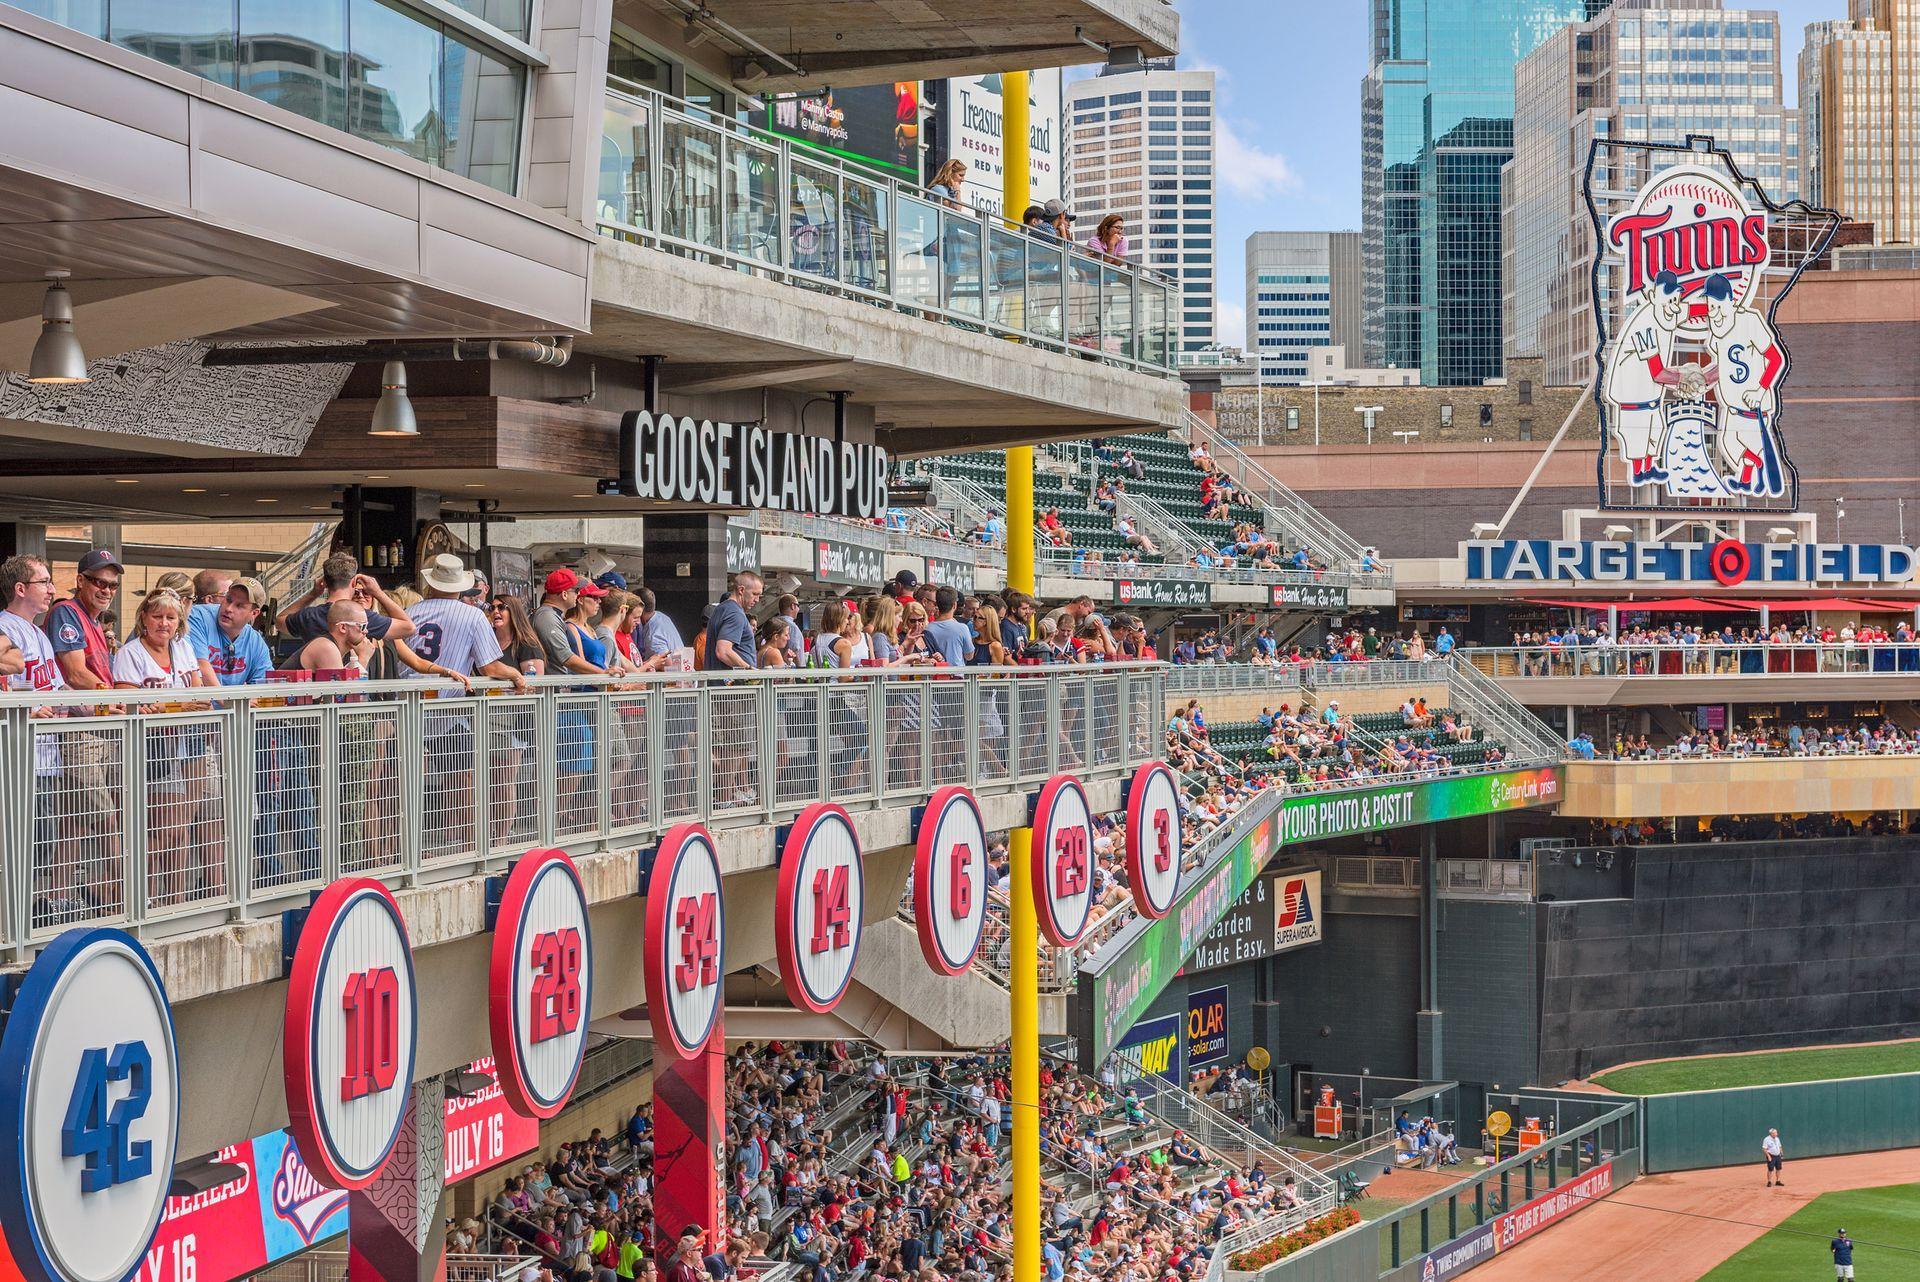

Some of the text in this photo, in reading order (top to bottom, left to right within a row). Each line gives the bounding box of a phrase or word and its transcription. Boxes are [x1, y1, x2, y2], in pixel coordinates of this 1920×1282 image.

[801, 99, 824, 117] Manny
[824, 105, 844, 121] Castro
[801, 117, 849, 140] @Mannyapolis
[961, 136, 1000, 157] RESORT
[974, 158, 991, 172] RED
[1610, 204, 1767, 295] Twins
[635, 410, 889, 519] GOOSE ISLAND PUB
[1468, 539, 1919, 582] TARGET FIELD
[1154, 582, 1173, 603] Home
[1174, 583, 1188, 605] Run
[1188, 583, 1207, 605] Porch
[1301, 587, 1317, 606] Home
[1317, 588, 1329, 608] Run
[1329, 588, 1345, 608] Porch
[1501, 777, 1557, 803] CenturyLink prism
[1153, 808, 1172, 873] 3
[1282, 803, 1317, 840] YOUR
[1319, 797, 1359, 833] PHOTO
[1361, 796, 1370, 828] &
[1373, 793, 1401, 826] POST
[1403, 791, 1413, 821] IT
[950, 842, 972, 921] 6
[1056, 825, 1087, 899] 29
[810, 864, 851, 955] 14
[1257, 879, 1266, 903] &
[675, 892, 719, 994] 34
[1195, 936, 1267, 969] Made Easy.
[530, 926, 582, 1045] 28
[340, 965, 400, 1104] 10
[61, 1040, 153, 1193] 42
[445, 1112, 504, 1179] JULY 16
[1503, 1214, 1516, 1246] 25
[1515, 1209, 1532, 1236] YEARS
[1532, 1206, 1540, 1227] OF
[1540, 1196, 1556, 1223] GIVING
[1556, 1191, 1568, 1214] KIDS
[1568, 1189, 1573, 1208] A
[1572, 1179, 1591, 1206] CHANCE
[1591, 1175, 1597, 1196] TO
[172, 1232, 197, 1282] 16
[1436, 1231, 1493, 1277] TWINS COMMUNITY FUND
